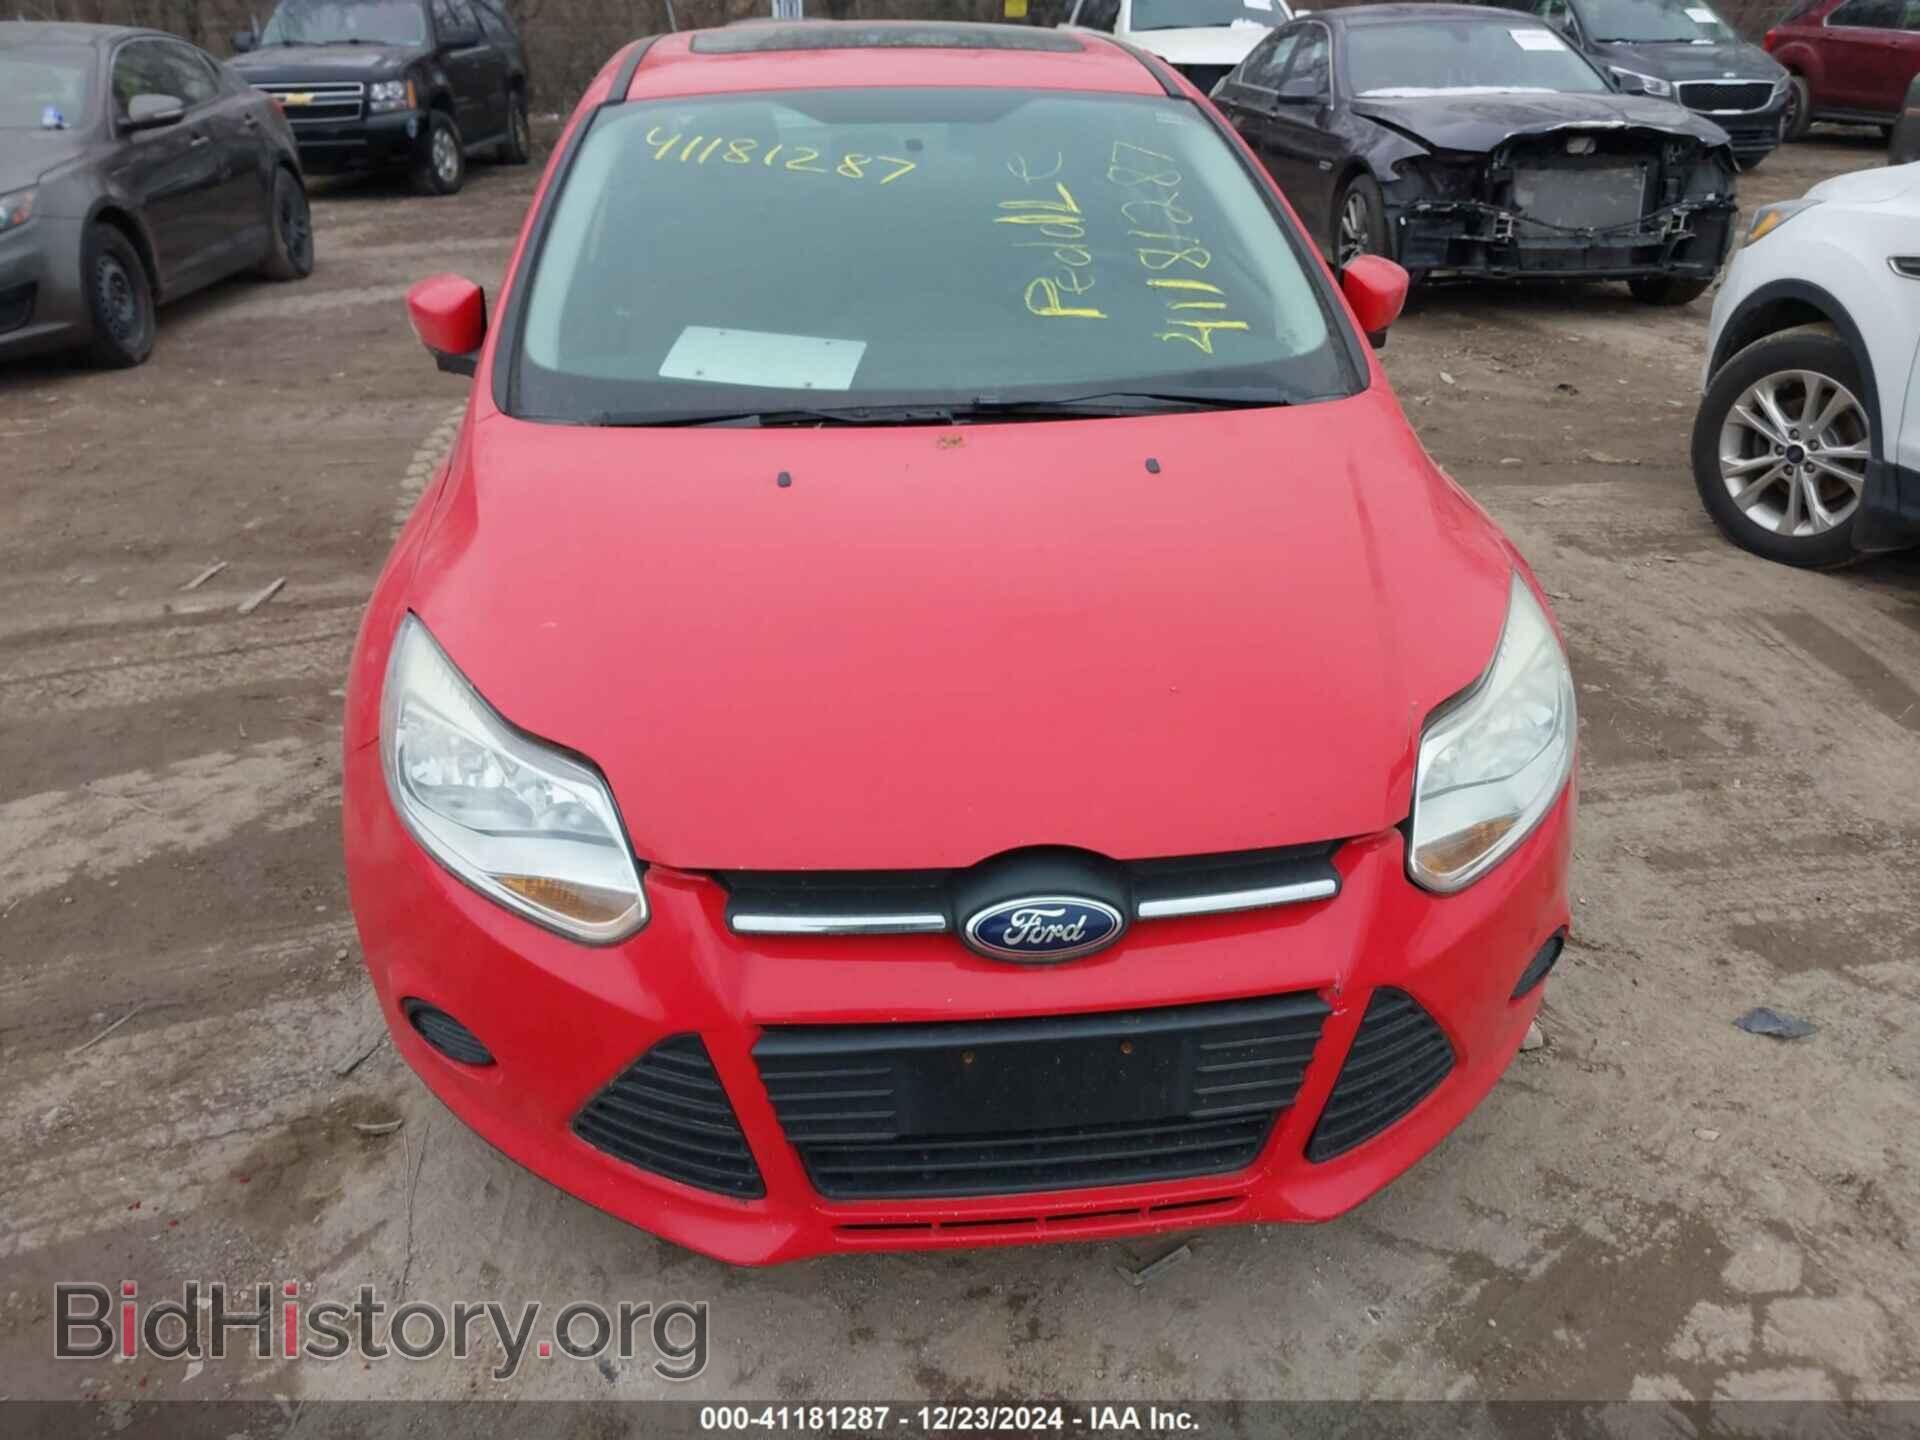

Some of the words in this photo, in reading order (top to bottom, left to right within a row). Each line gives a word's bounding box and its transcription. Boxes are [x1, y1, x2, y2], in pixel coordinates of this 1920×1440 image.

[645, 126, 917, 185] 41181287
[1106, 140, 1250, 354] 41181287
[1002, 908, 1088, 946] Ford
